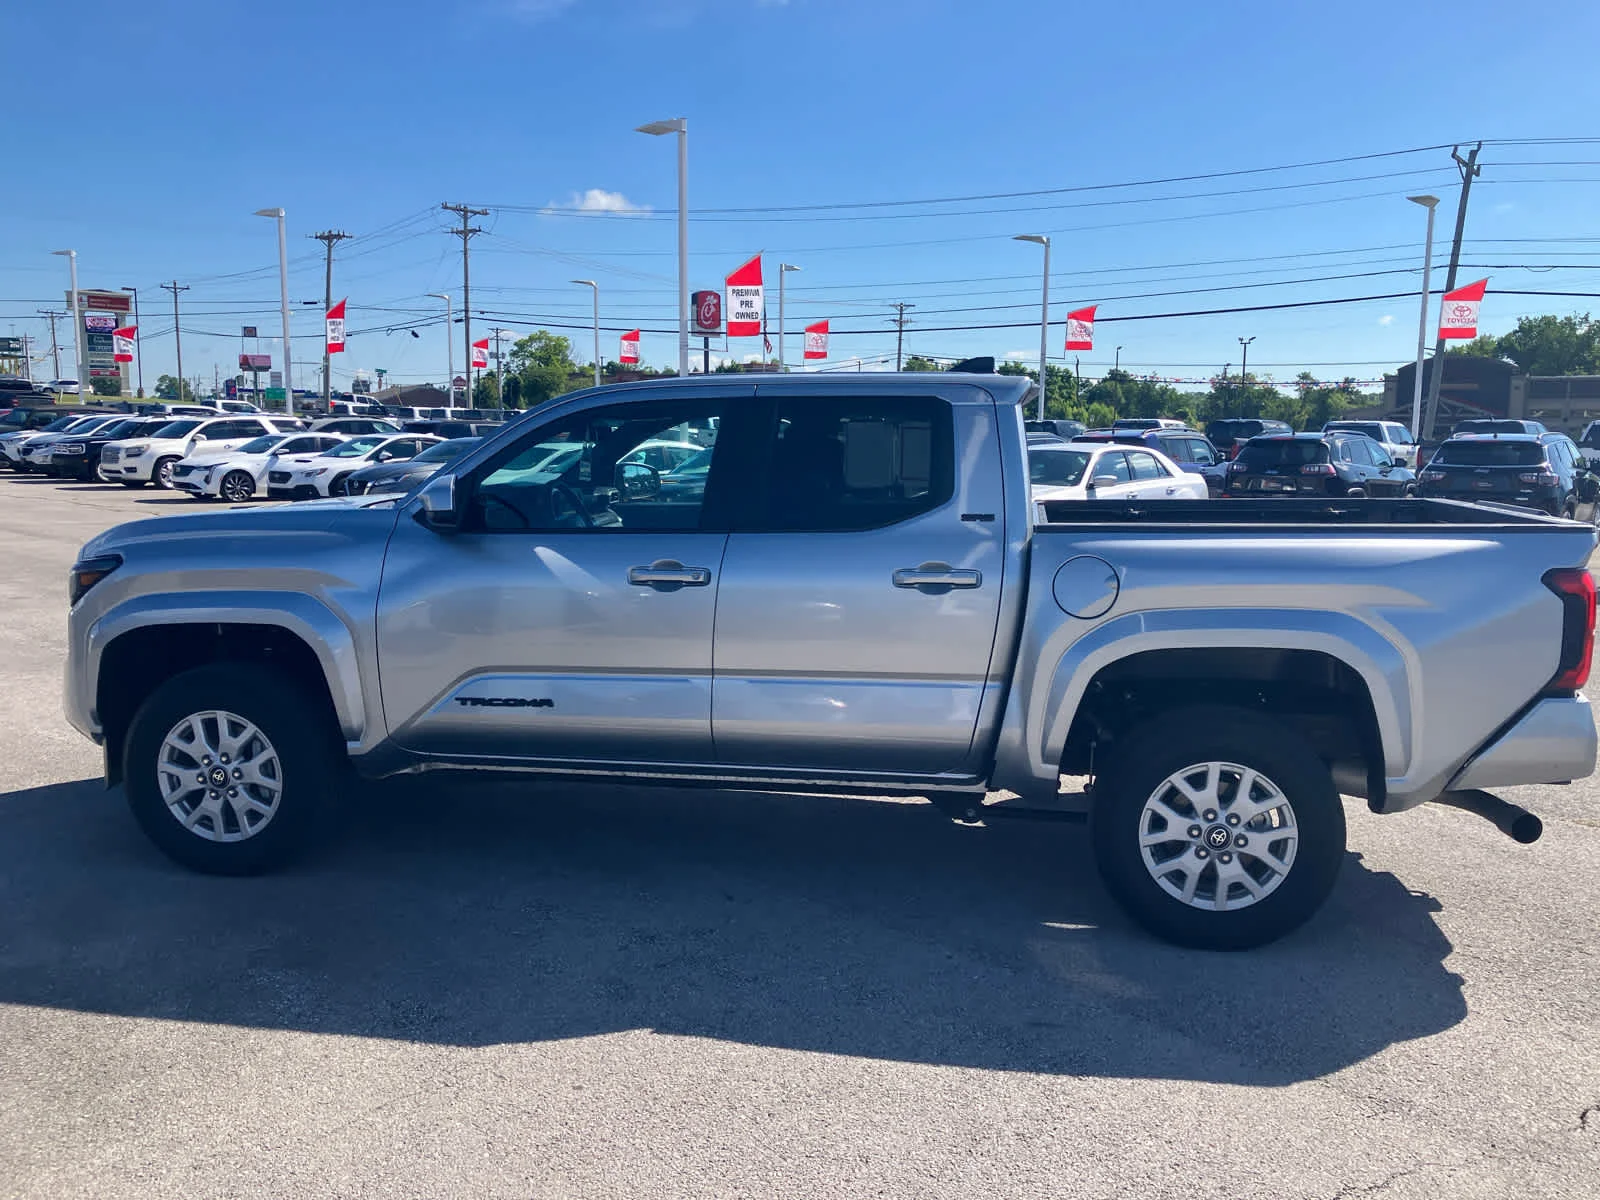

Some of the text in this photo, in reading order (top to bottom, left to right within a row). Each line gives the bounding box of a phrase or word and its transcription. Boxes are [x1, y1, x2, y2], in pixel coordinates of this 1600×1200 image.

[740, 299, 754, 309] PRE
[735, 311, 759, 320] OWNED
[1447, 317, 1476, 325] TOYOTA
[455, 697, 554, 707] TACOMA
